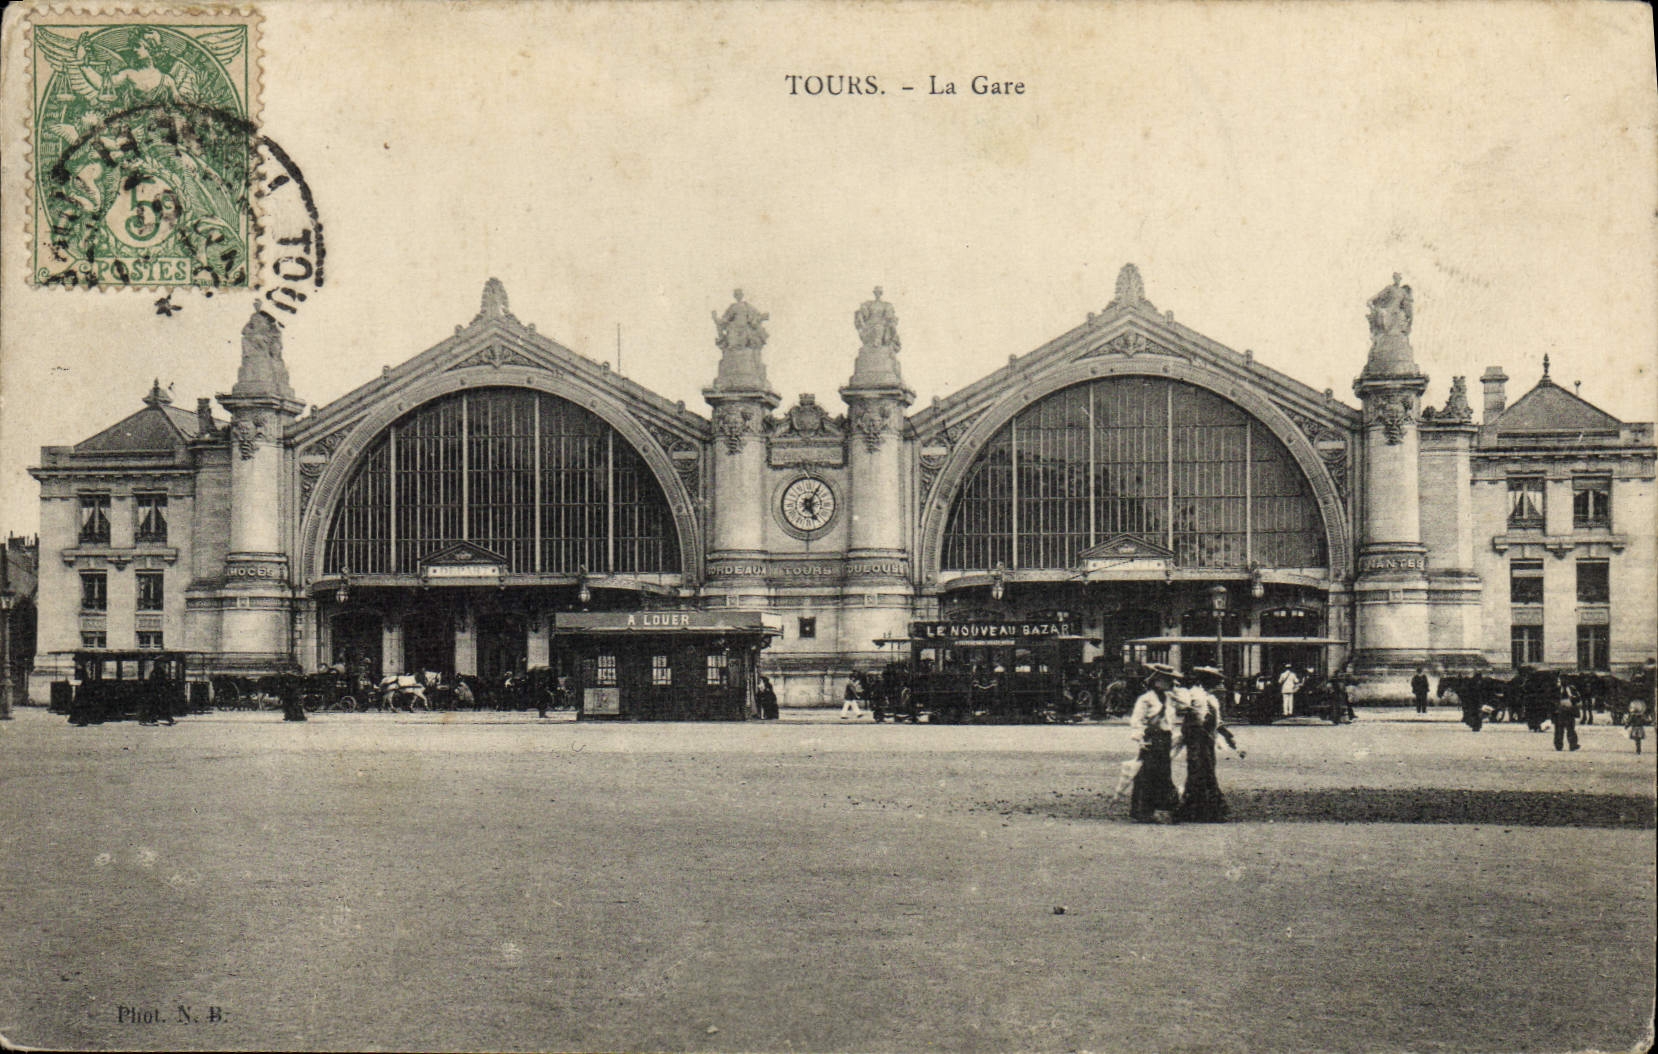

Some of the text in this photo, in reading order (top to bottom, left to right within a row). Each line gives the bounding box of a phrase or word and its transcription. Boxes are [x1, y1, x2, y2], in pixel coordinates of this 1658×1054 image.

[98, 259, 188, 283] POSTES
[783, 567, 833, 577] TOURS
[627, 614, 690, 626] A LOUER
[927, 623, 1070, 638] LE NOUVEAU BAZAR
